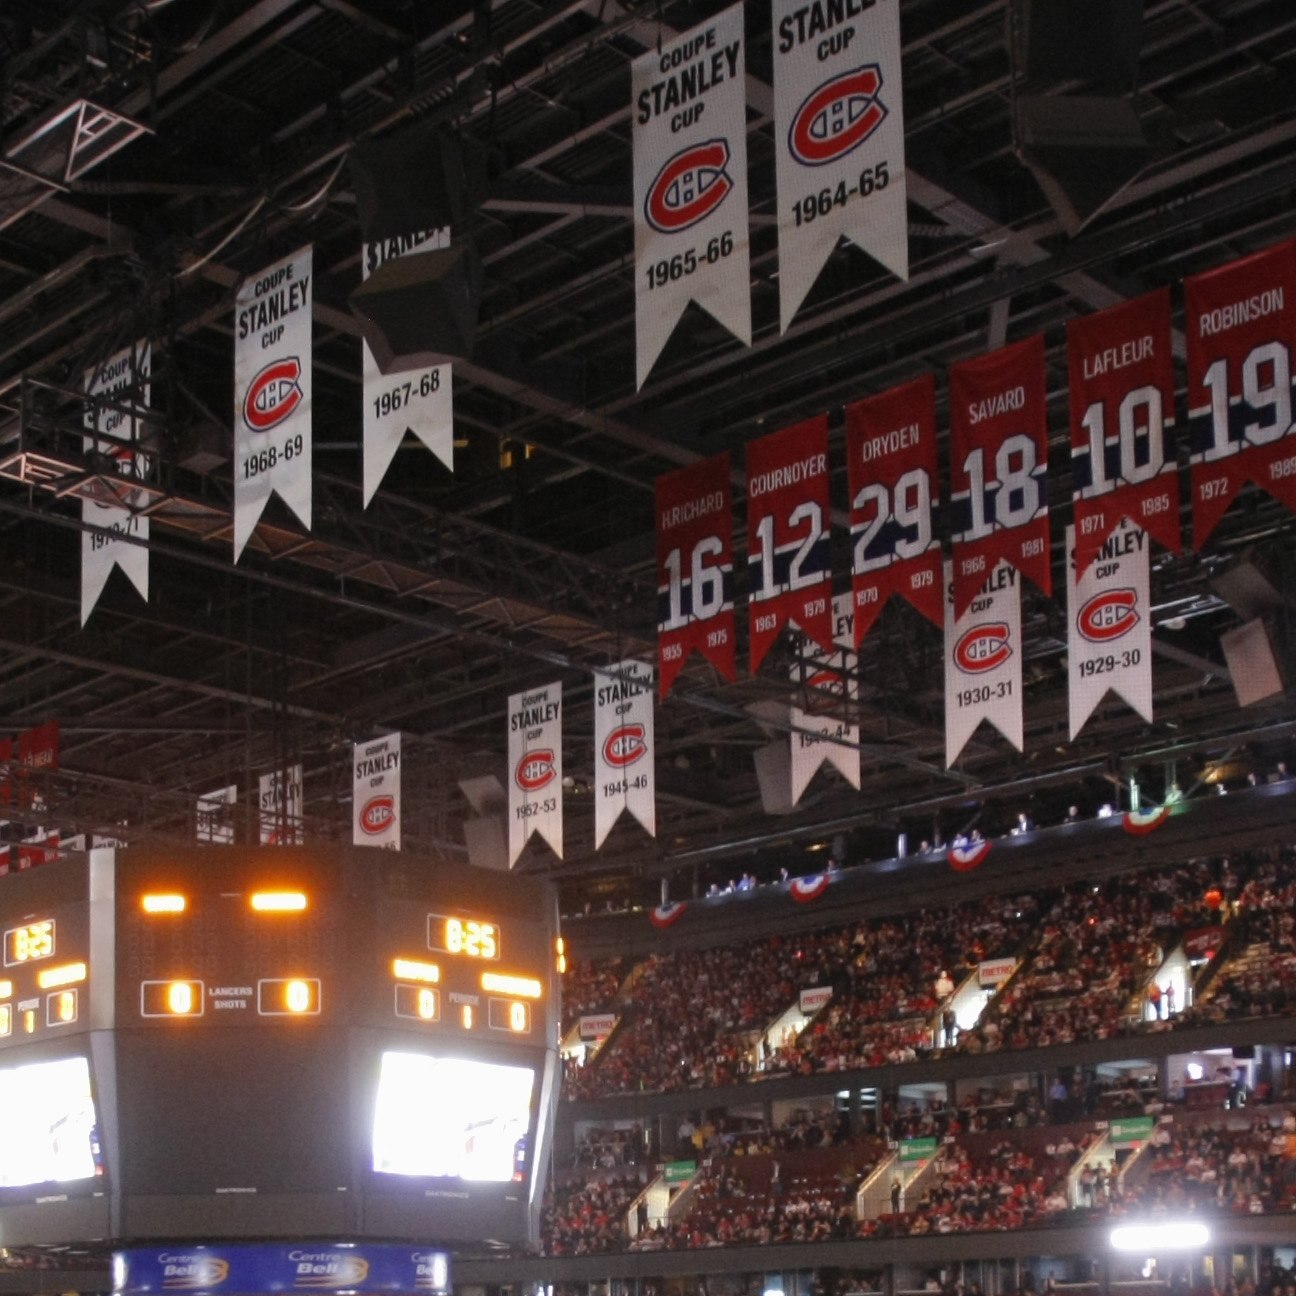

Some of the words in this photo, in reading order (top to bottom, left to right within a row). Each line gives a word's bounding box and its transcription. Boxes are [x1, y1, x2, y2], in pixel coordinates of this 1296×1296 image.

[659, 28, 716, 73] COUPE
[816, 27, 855, 61] CUP
[636, 41, 741, 126] STANLEY
[670, 102, 706, 133] CUP
[791, 161, 891, 228] 1964-65
[254, 262, 294, 298] COUPE
[646, 230, 734, 291] 1965-66
[238, 277, 310, 341] STANLEY
[1199, 286, 1285, 339] ROBINSON
[260, 325, 285, 349] CUP
[1083, 335, 1154, 380] LAFLEUR
[373, 368, 441, 420] 1967-68
[968, 386, 1025, 426] SAVARD
[1202, 339, 1293, 463] 19
[243, 434, 304, 480] 1968-69
[862, 423, 920, 463] DRYDEN
[1081, 384, 1166, 500] 10
[749, 453, 827, 498] COURNOYER
[962, 433, 1040, 543] 18
[1199, 477, 1229, 502] 1972
[853, 467, 933, 576] 29
[1080, 512, 1105, 535] 1971
[1141, 492, 1170, 517] 1985
[755, 500, 824, 603] 12
[1021, 537, 1044, 559] 1981
[662, 535, 725, 633] 16
[1096, 563, 1120, 579] CUP
[971, 597, 994, 615] CUP
[1078, 649, 1141, 679] 1929-30
[956, 680, 1013, 709] 1930-31
[511, 702, 561, 732] STANLEY
[356, 751, 400, 780] STANLEY
[603, 774, 648, 798] 1945-46
[163, 1264, 198, 1277] Bell
[288, 1250, 342, 1263] Centre
[296, 1262, 339, 1275] Bell
